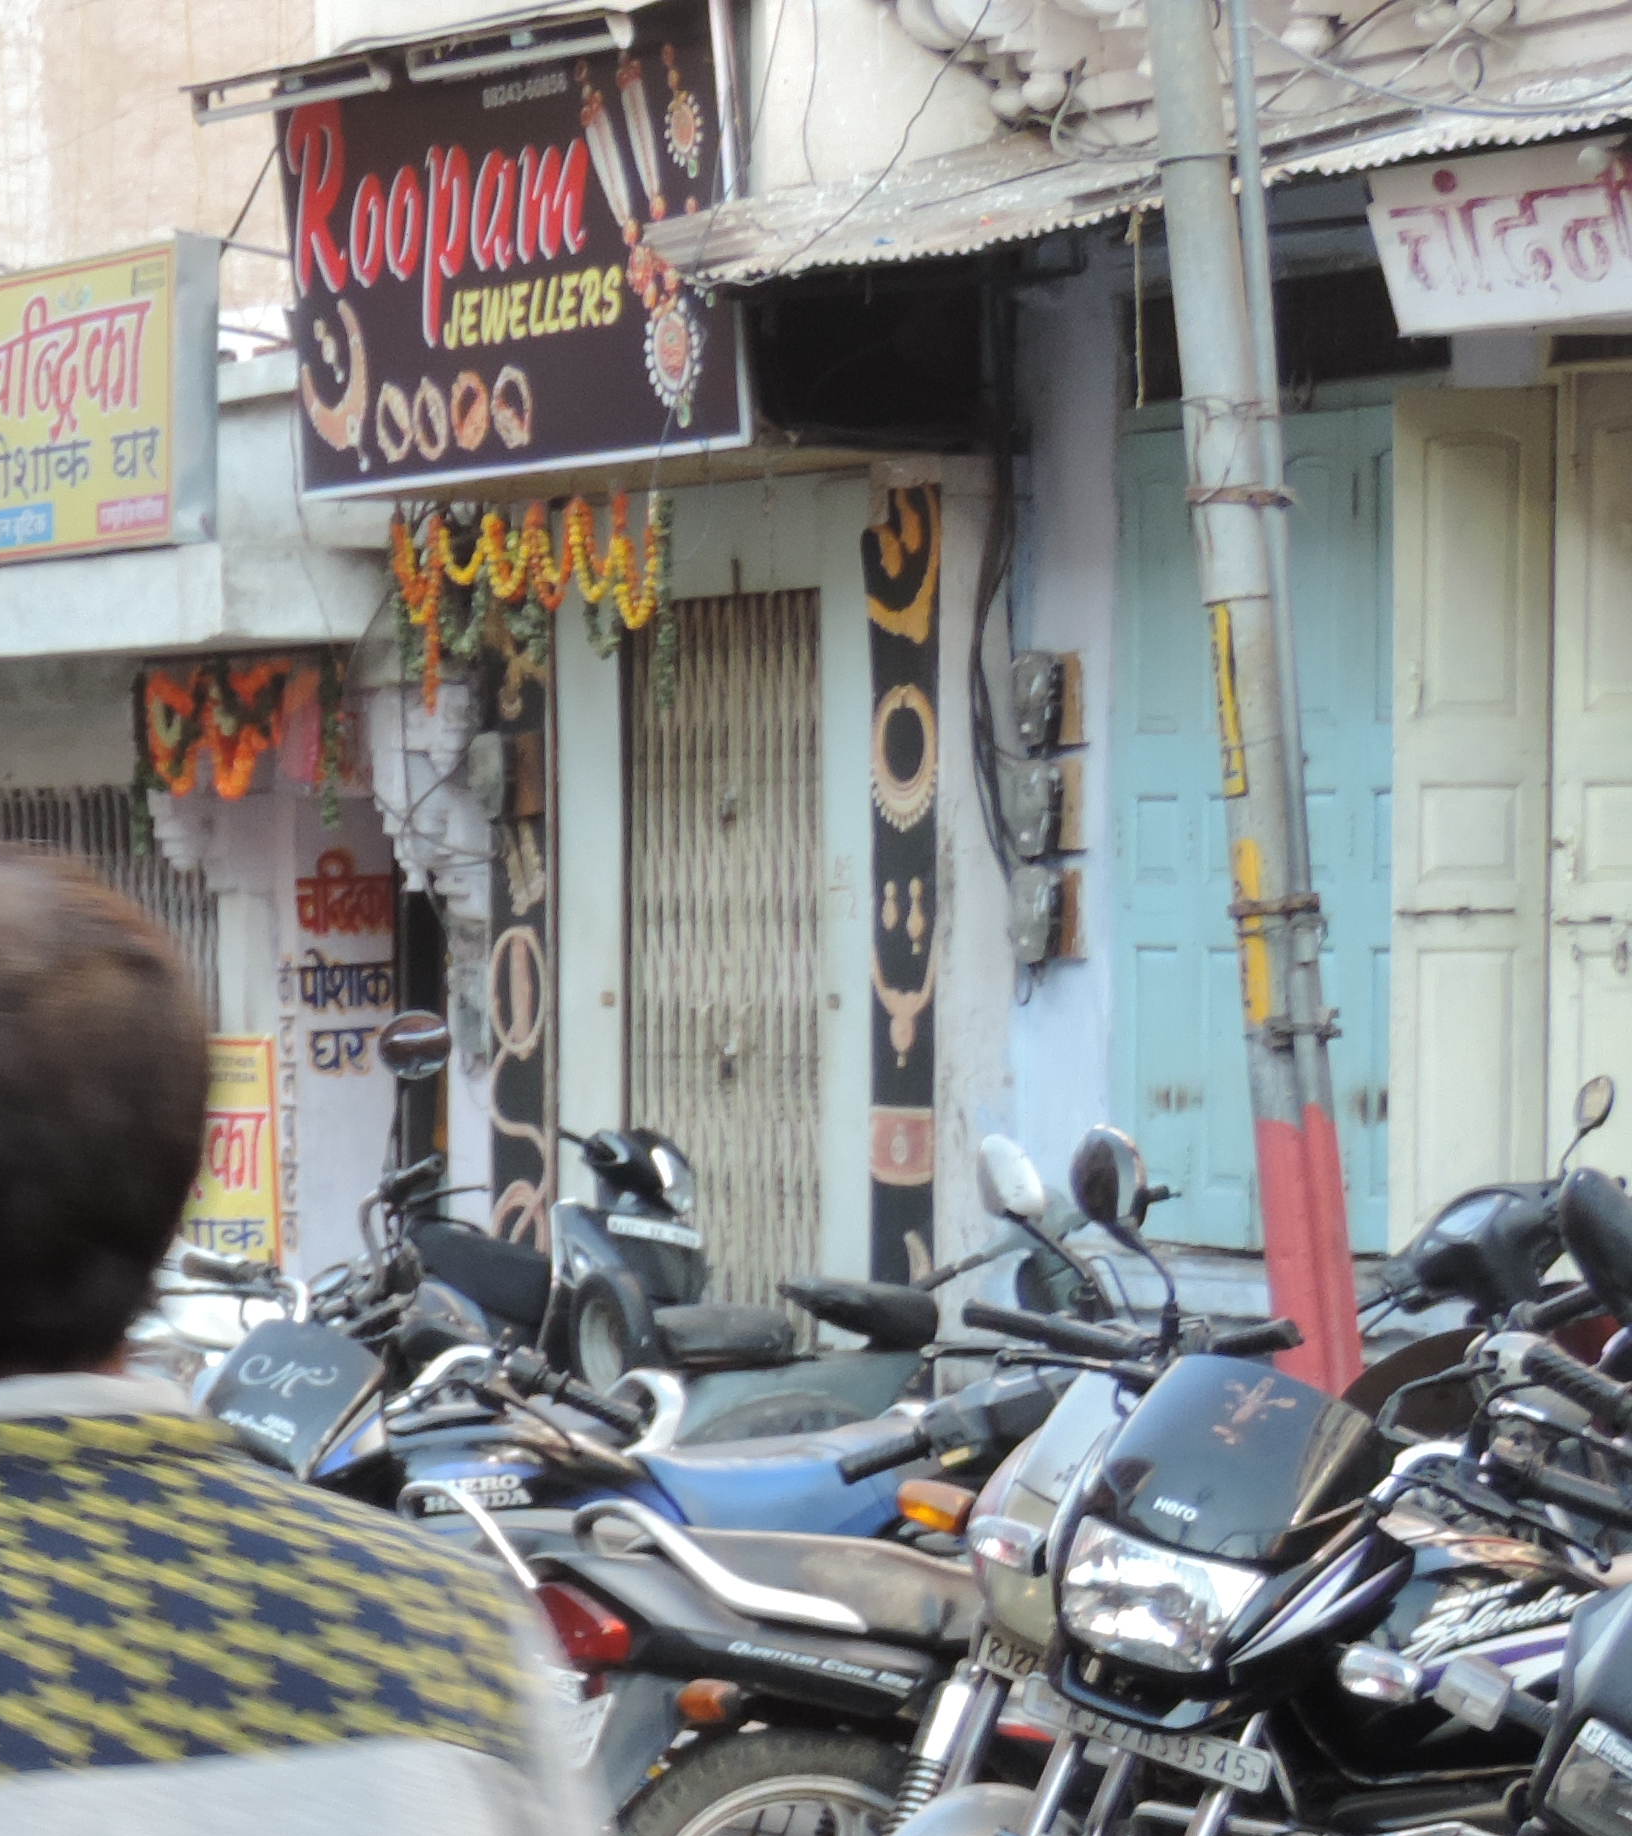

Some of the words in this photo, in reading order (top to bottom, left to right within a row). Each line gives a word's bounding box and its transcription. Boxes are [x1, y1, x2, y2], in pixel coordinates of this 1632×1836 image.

[287, 97, 588, 348] Roopam
[443, 265, 623, 350] JEWELLERS
[111, 426, 160, 480] घर
[309, 1026, 377, 1072] घर
[1152, 1495, 1199, 1522] Hero
[1398, 1584, 1601, 1665] Splendor
